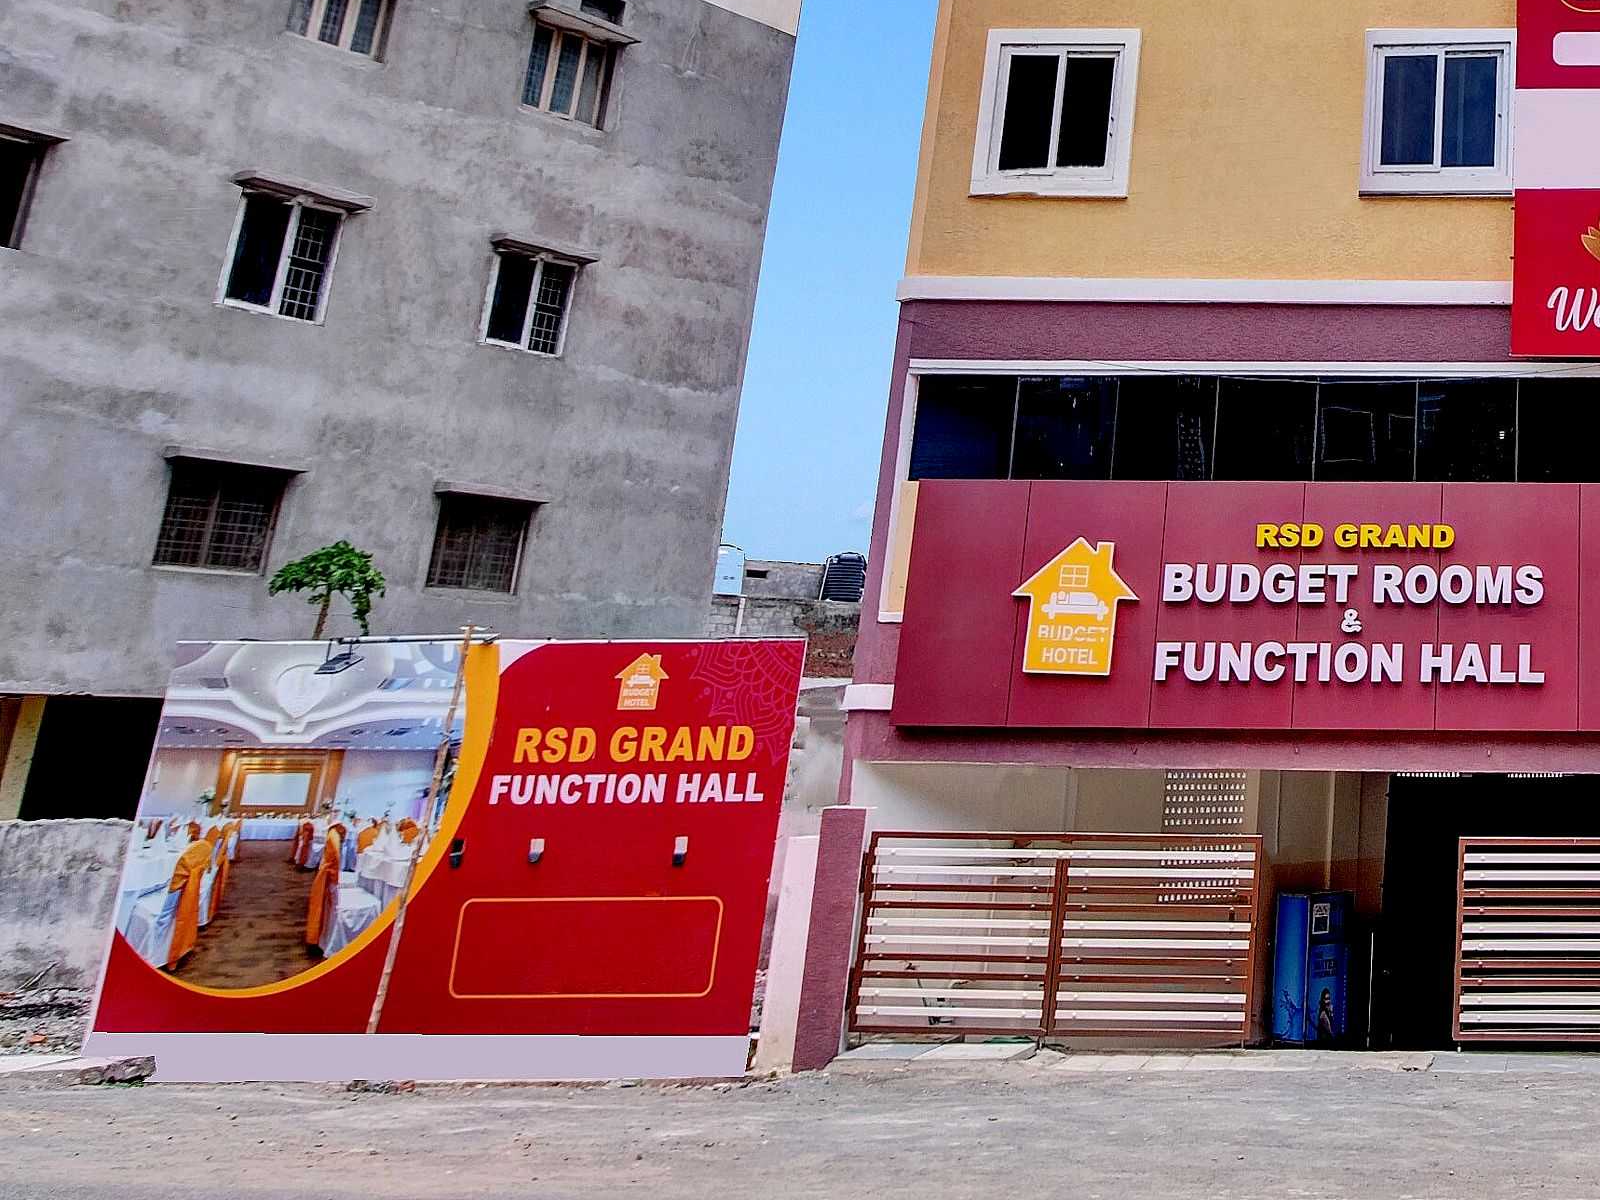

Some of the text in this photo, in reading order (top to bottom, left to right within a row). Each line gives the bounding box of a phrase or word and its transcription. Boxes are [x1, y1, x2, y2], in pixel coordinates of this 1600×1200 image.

[1255, 523, 1456, 550] RSD GRAND
[1162, 563, 1545, 606] BUDGET ROOMS
[1037, 624, 1108, 643] BUDGET
[1340, 608, 1363, 634] &
[1040, 647, 1099, 666] HOTEL
[1153, 641, 1547, 685] FUNCTION HALL
[621, 688, 655, 698] BUDGET
[624, 698, 650, 707] HOTEL
[513, 725, 756, 764] RSD GRAND
[488, 771, 765, 806] FUNCTION HALL
